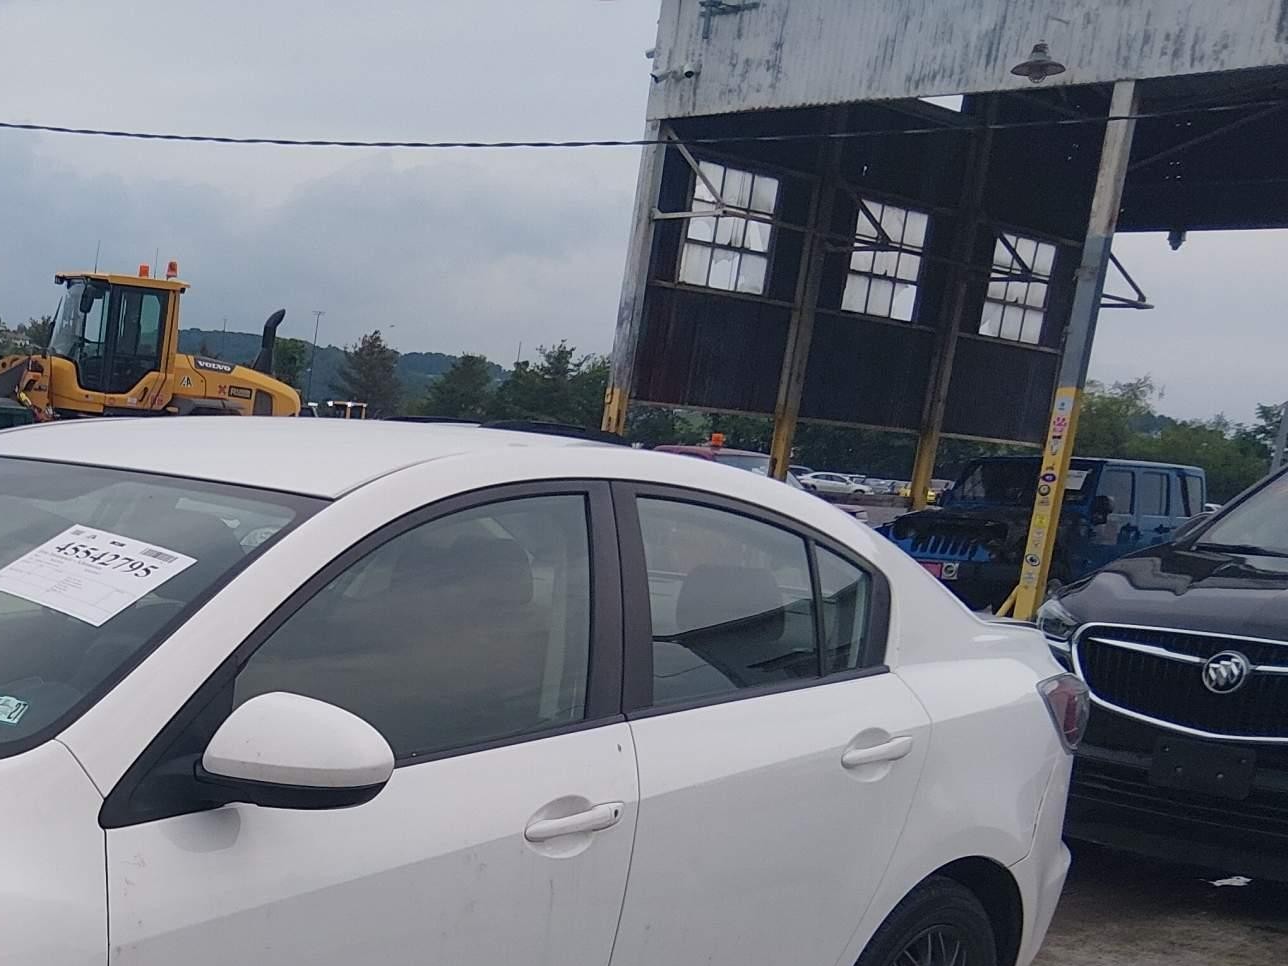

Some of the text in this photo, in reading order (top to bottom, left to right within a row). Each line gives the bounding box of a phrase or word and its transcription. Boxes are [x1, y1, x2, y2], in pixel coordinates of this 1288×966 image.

[198, 360, 231, 371] VOLVO
[55, 542, 159, 578] 45542795
[7, 703, 28, 721] 27
